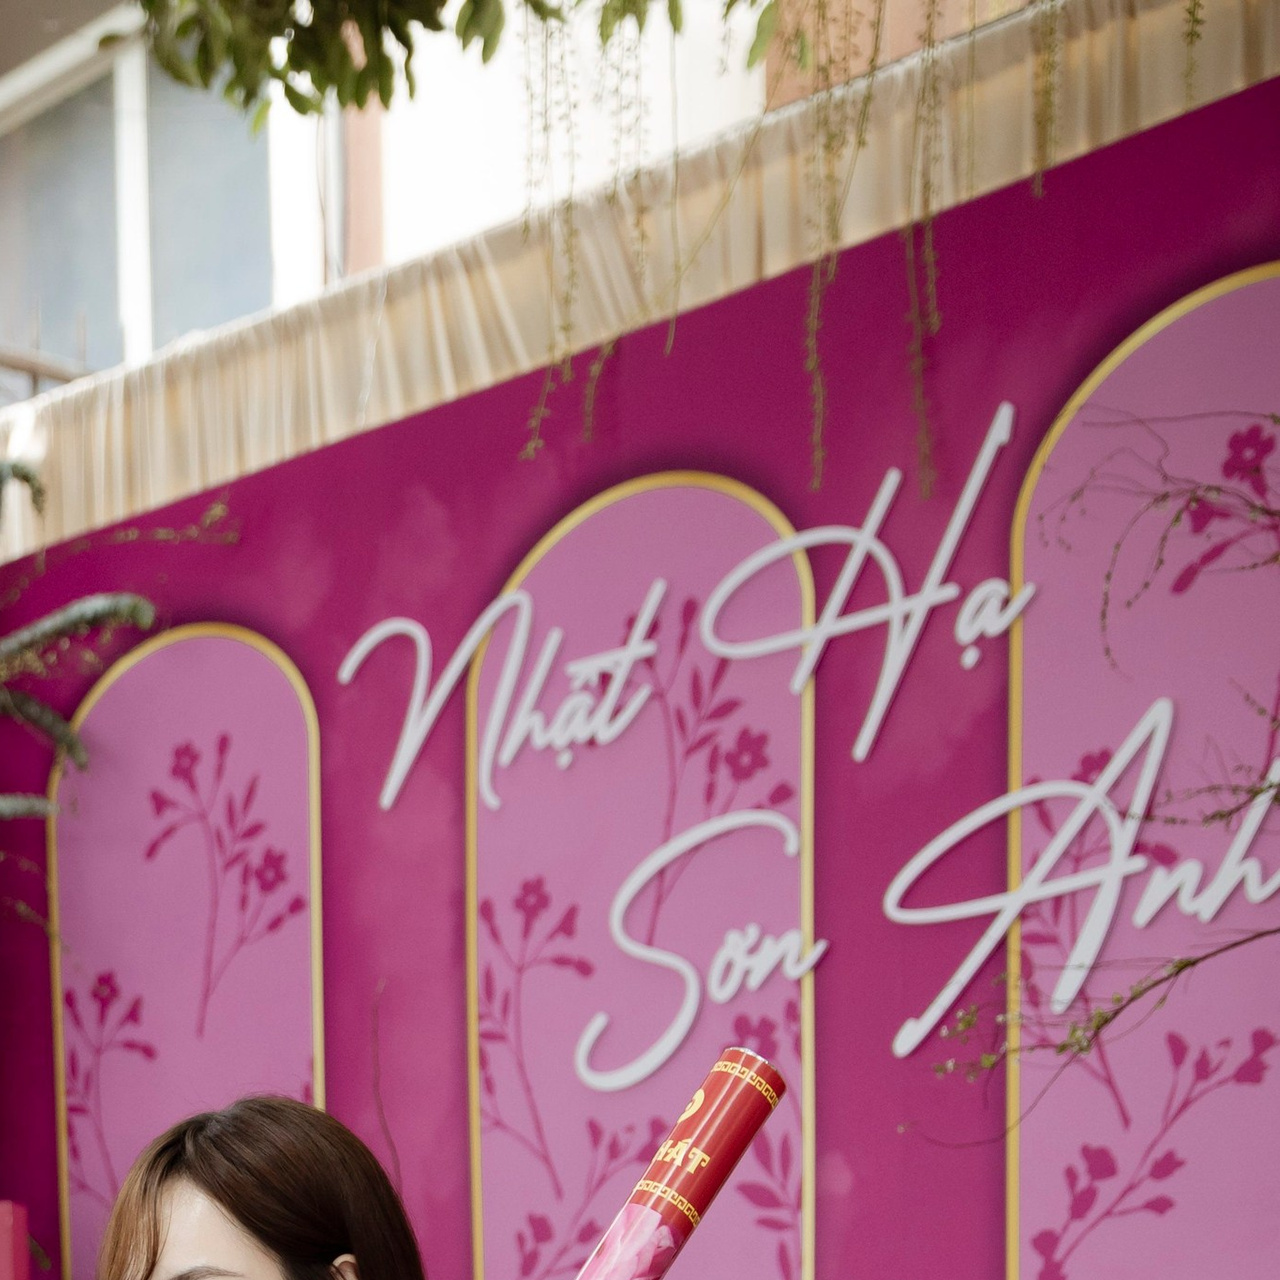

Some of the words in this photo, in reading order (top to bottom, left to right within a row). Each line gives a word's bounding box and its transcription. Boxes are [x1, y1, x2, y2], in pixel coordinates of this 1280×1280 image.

[337, 576, 668, 811] Nhật
[699, 400, 1037, 762] Hạ
[574, 808, 829, 1092] Sơn
[883, 697, 1280, 1059] Anh
